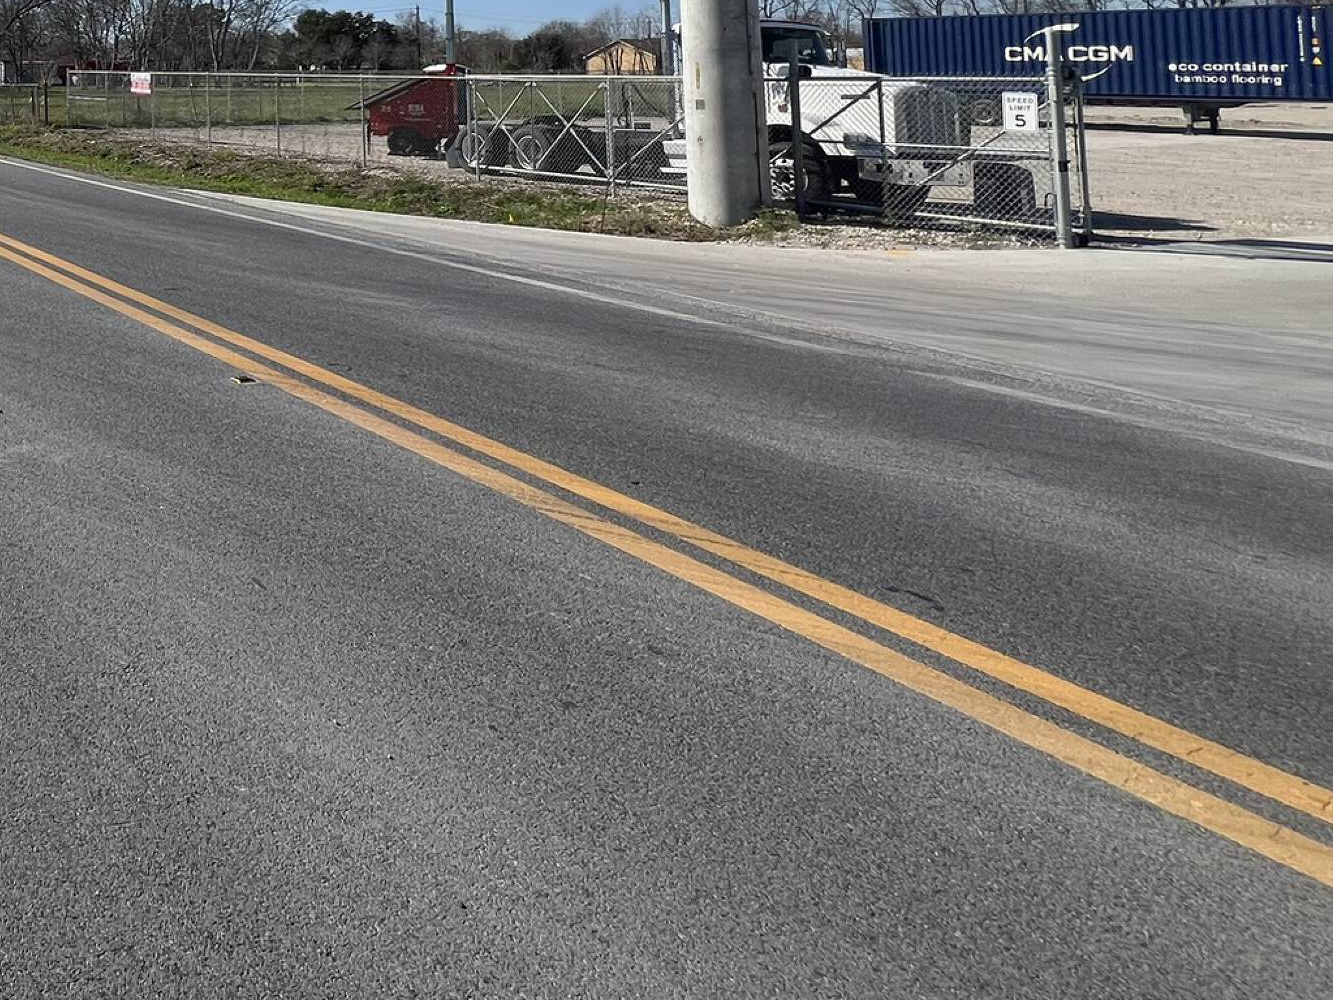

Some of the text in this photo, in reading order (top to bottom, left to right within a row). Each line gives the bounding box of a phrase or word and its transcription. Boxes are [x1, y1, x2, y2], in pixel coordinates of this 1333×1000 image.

[1004, 44, 1133, 62] CM CGM
[1168, 61, 1289, 73] eco container
[1174, 73, 1282, 87] bamboo flooring
[1015, 114, 1026, 127] 5
